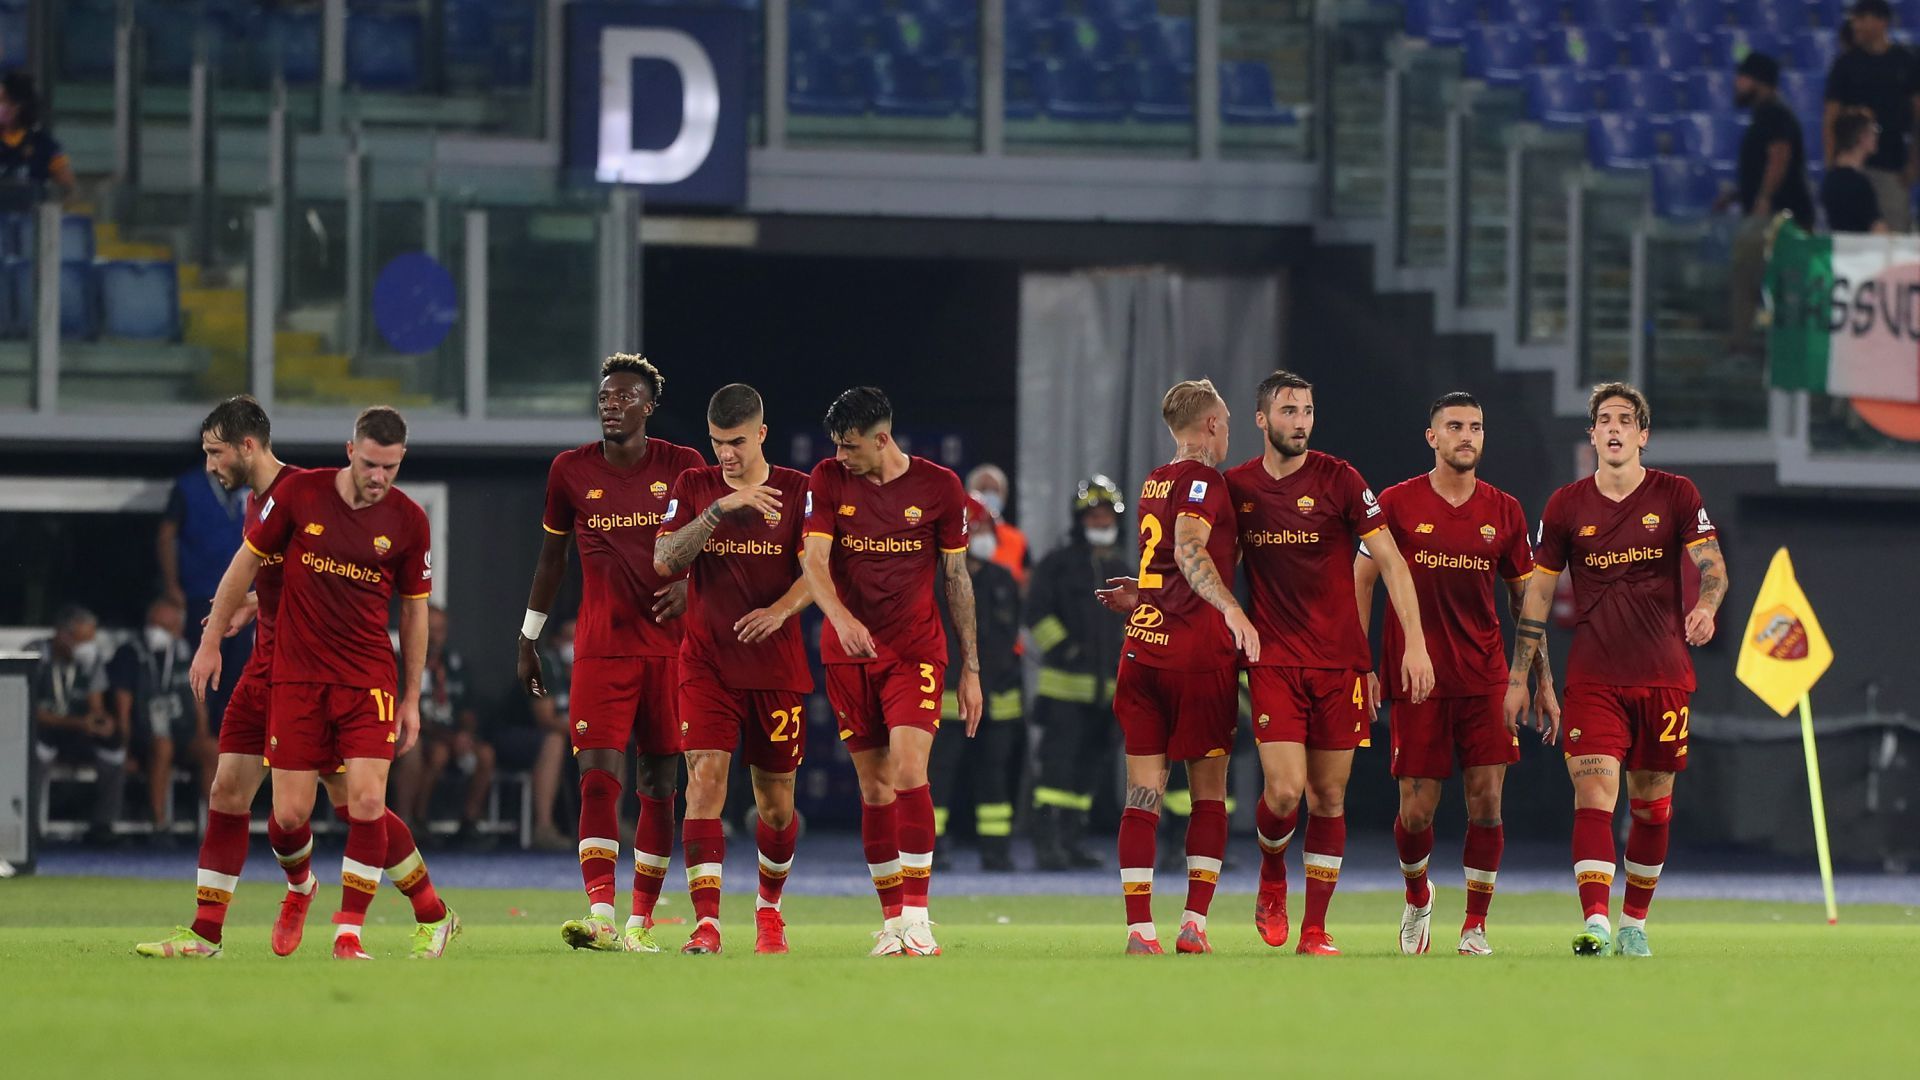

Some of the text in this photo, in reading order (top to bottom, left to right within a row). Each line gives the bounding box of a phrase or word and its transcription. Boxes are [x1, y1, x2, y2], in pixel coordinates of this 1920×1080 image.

[597, 27, 720, 184] D
[703, 539, 782, 556] digitalbits
[841, 534, 922, 553] digitalbits
[1138, 513, 1163, 589] 2
[1585, 546, 1664, 569] digitalbits
[301, 552, 382, 583] digitalbits
[1414, 550, 1490, 571] digitalbits
[920, 663, 936, 693] 3
[1353, 677, 1364, 710] 4
[370, 688, 394, 721] 17
[771, 706, 802, 742] 23
[1659, 706, 1689, 742] 22
